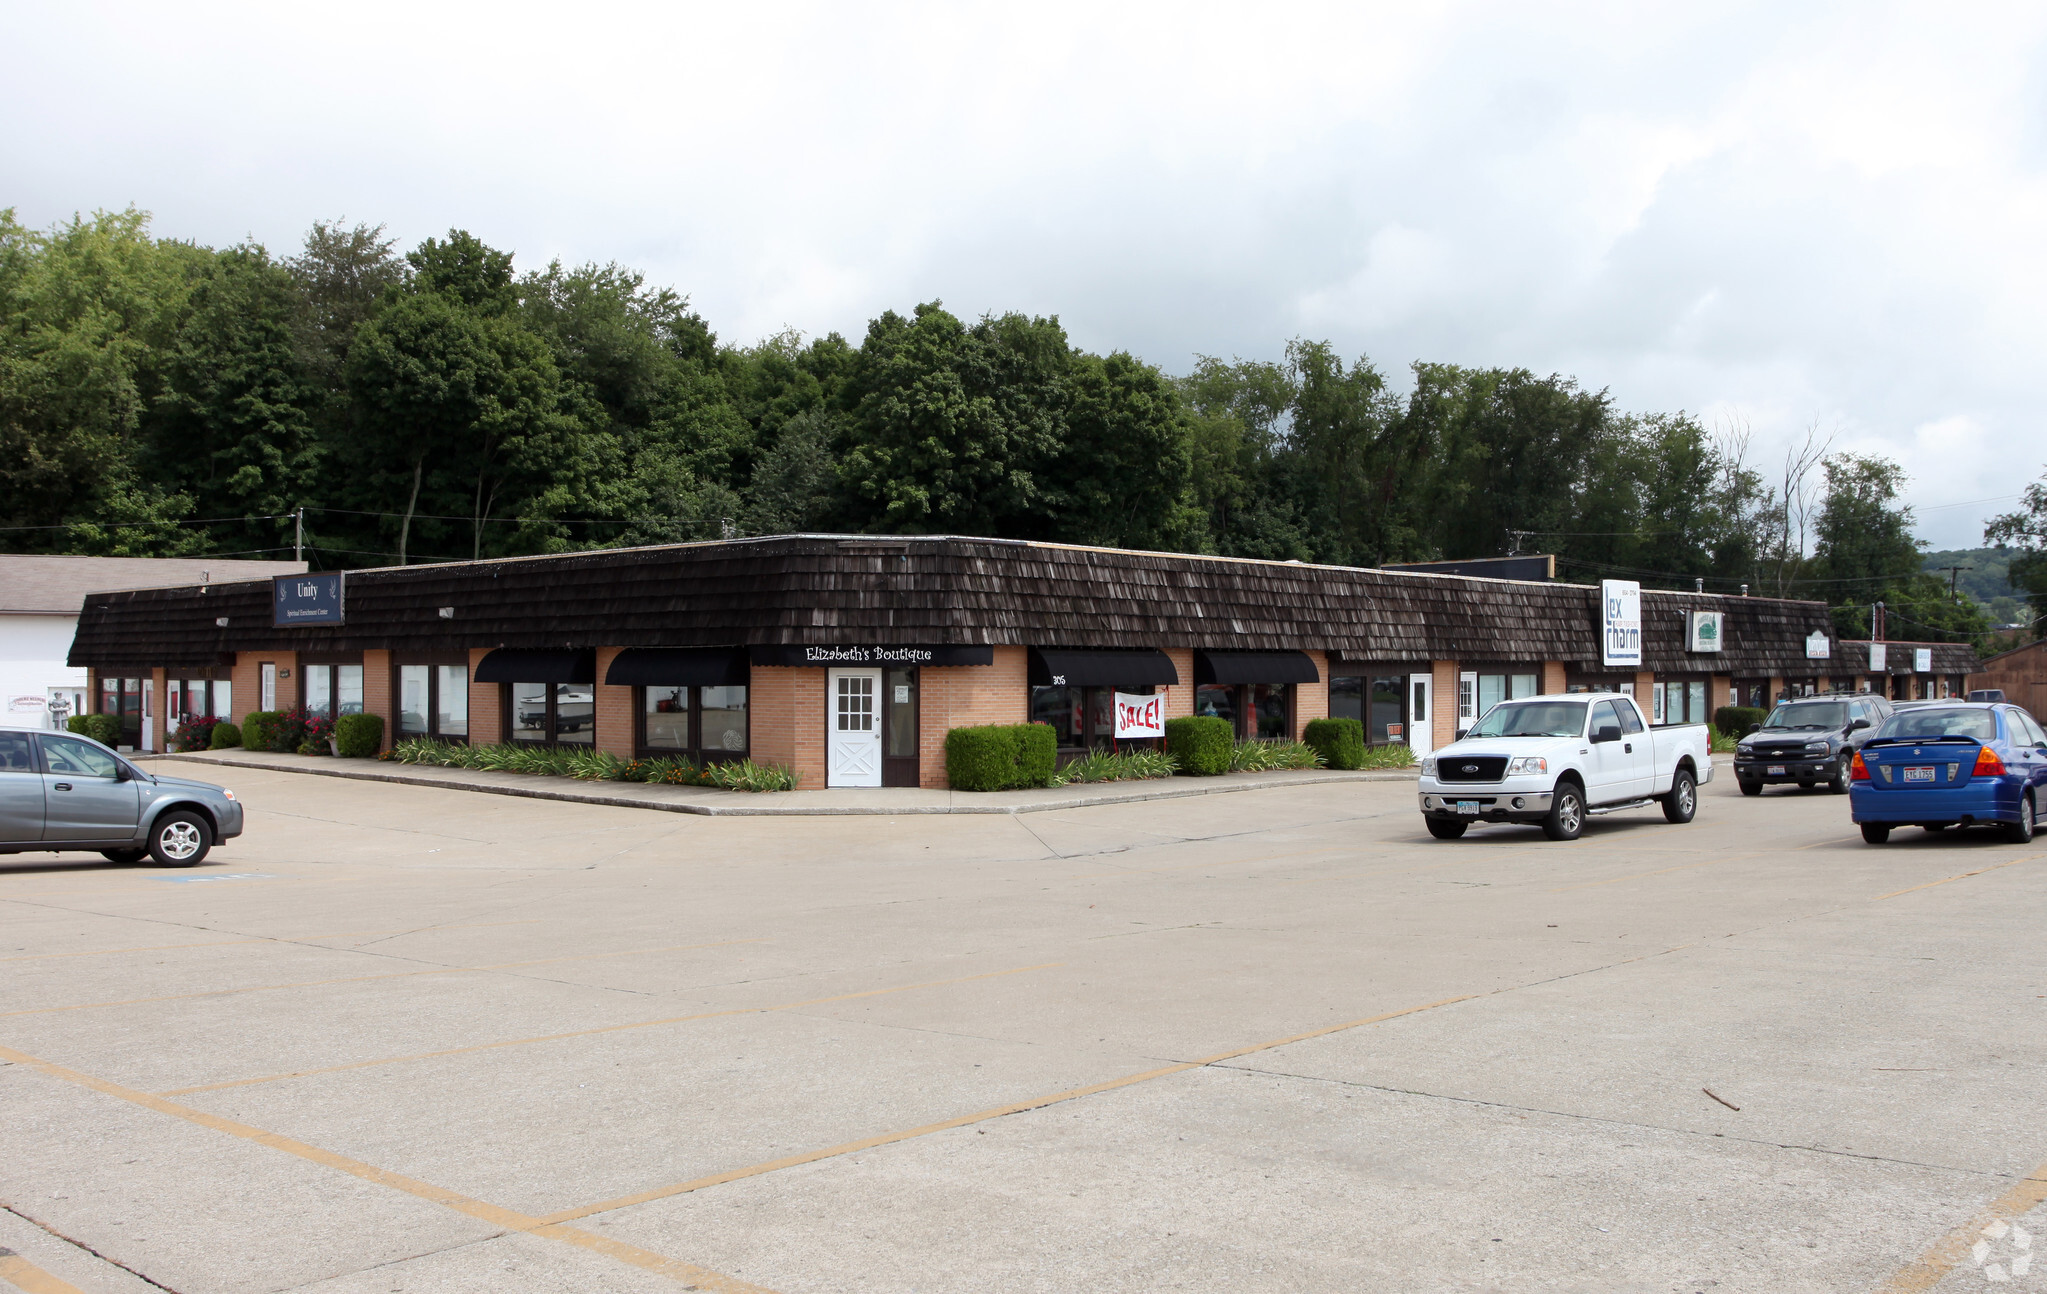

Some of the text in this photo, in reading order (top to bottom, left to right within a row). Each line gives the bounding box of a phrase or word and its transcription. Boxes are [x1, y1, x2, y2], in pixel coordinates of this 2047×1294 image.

[297, 582, 318, 600] Unity
[287, 609, 299, 618] Spiritual
[300, 608, 317, 616] Enrichment
[1605, 586, 1622, 626] Lex
[806, 646, 932, 663] Elizabeth's Boutique
[1052, 675, 1066, 685] 305
[1119, 698, 1160, 731] SALE!
